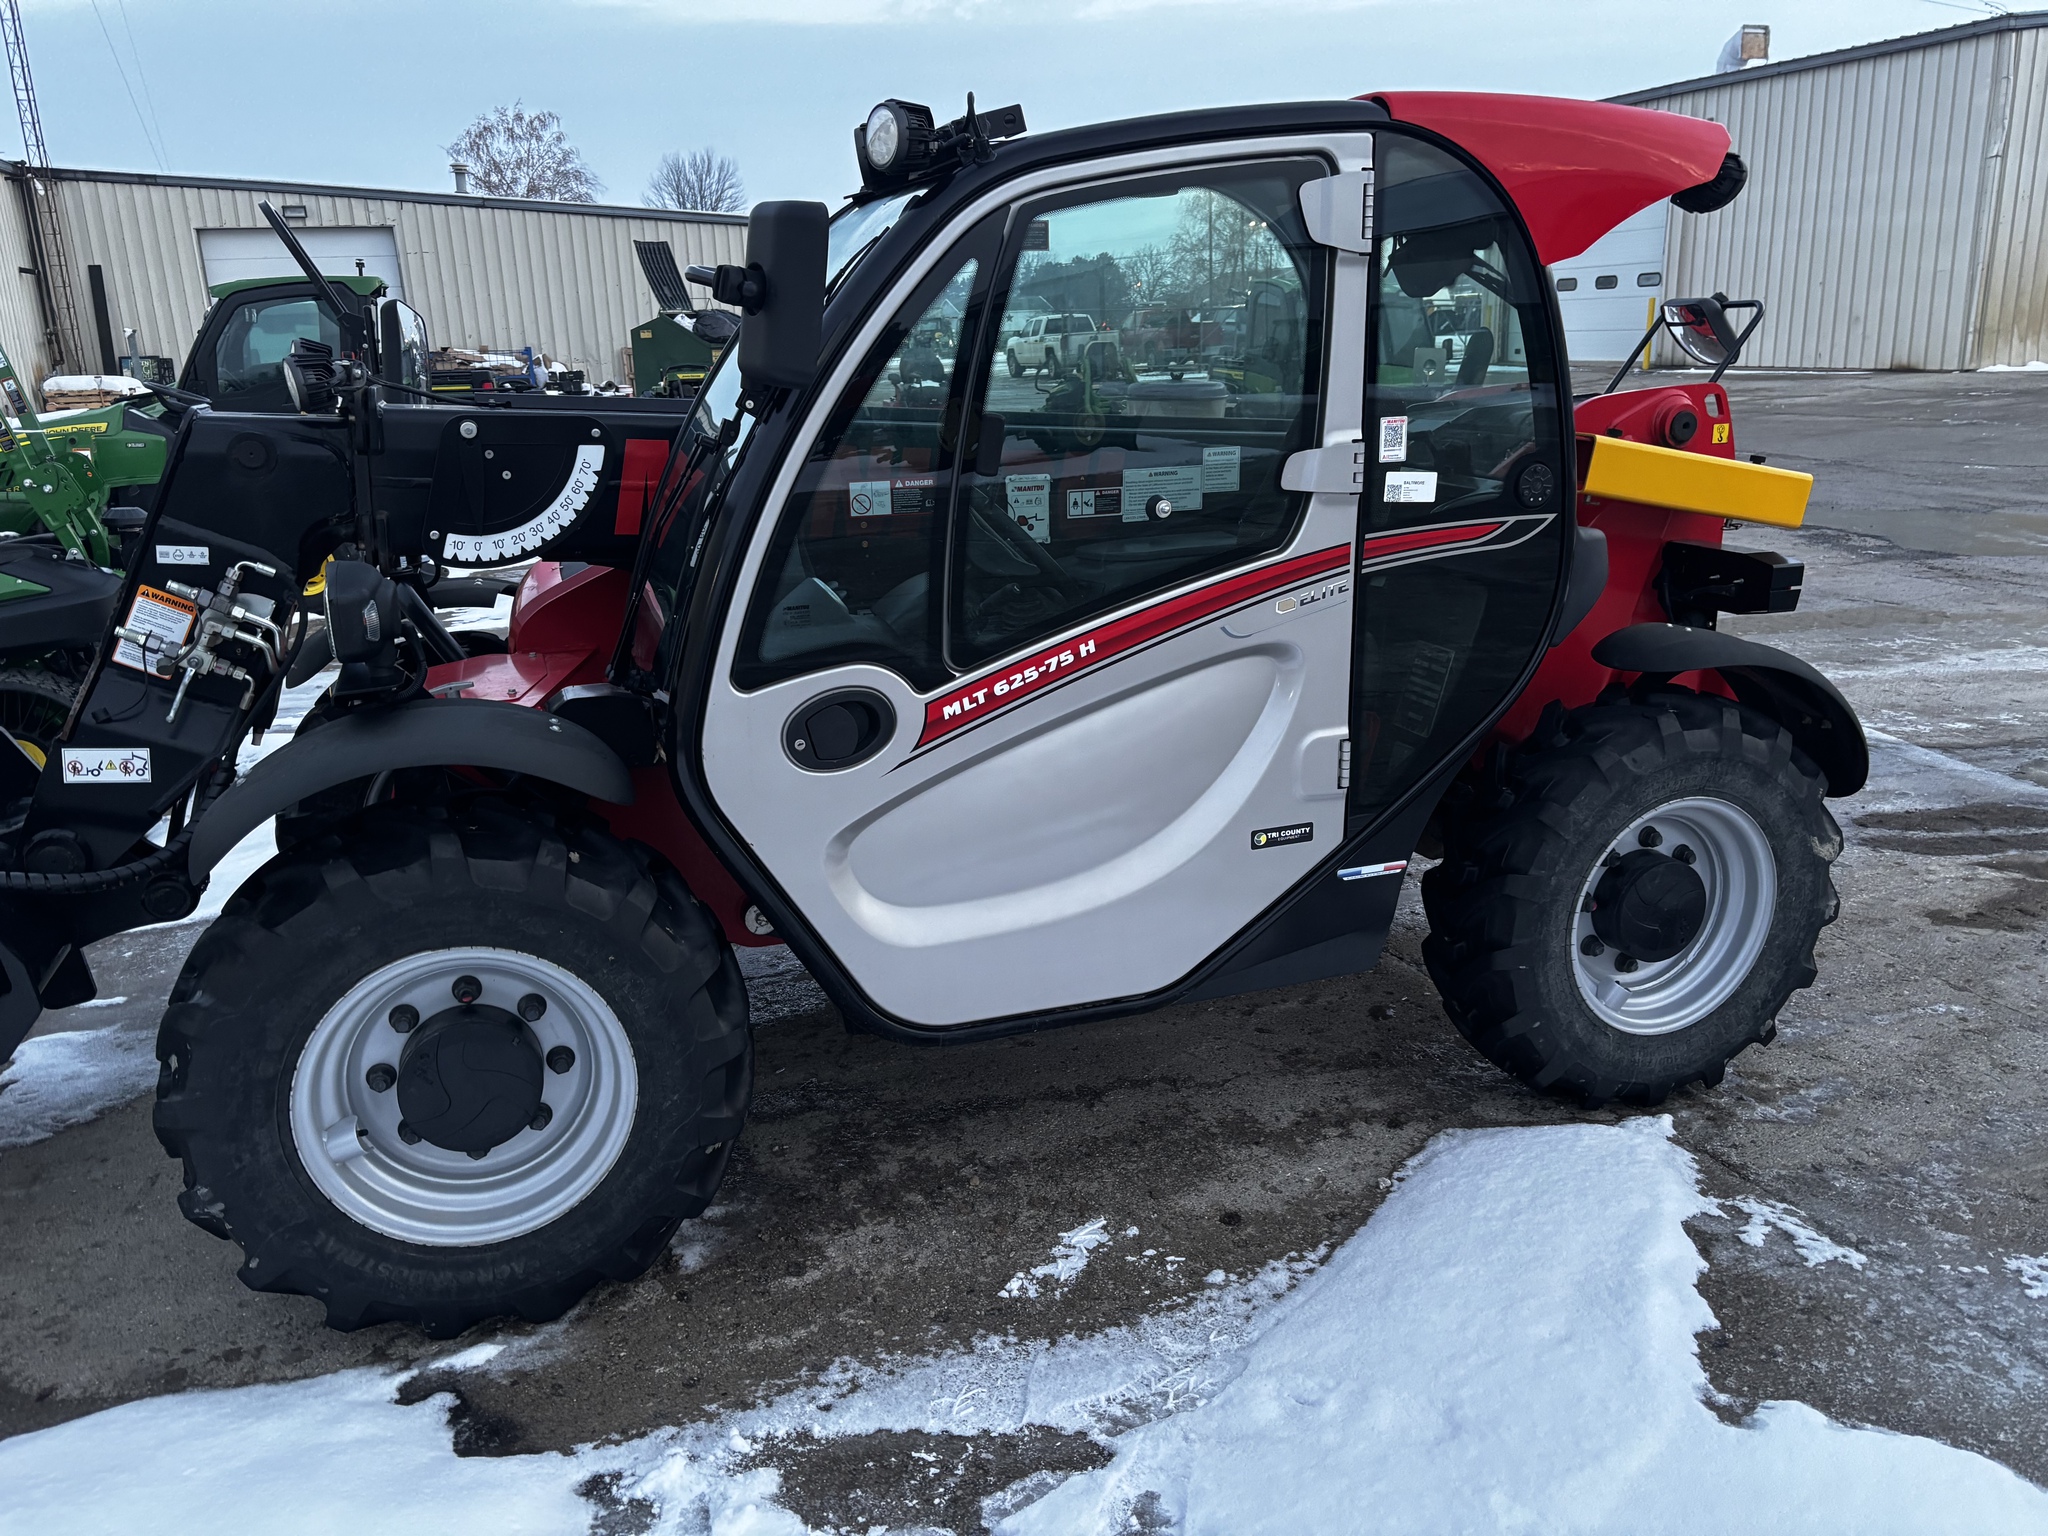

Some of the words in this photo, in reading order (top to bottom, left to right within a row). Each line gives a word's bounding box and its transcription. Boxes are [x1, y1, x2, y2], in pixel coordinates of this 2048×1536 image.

[905, 479, 934, 487] DANGER
[474, 541, 483, 552] 0°
[492, 538, 505, 549] 10°
[510, 531, 526, 546] 20°
[529, 521, 545, 537] 30°
[547, 509, 561, 525] 40°
[559, 494, 574, 512] 50°
[571, 478, 585, 495] 60°
[578, 459, 592, 476] 70°
[151, 592, 195, 613] WARNING
[1299, 579, 1350, 607] ELITE
[942, 688, 988, 720] MLT
[993, 649, 1075, 696] 625-75
[1078, 638, 1096, 658] H
[1267, 831, 1279, 839] TRI
[1281, 826, 1311, 837] COUNTY
[1277, 834, 1300, 842] EQUIPMENT
